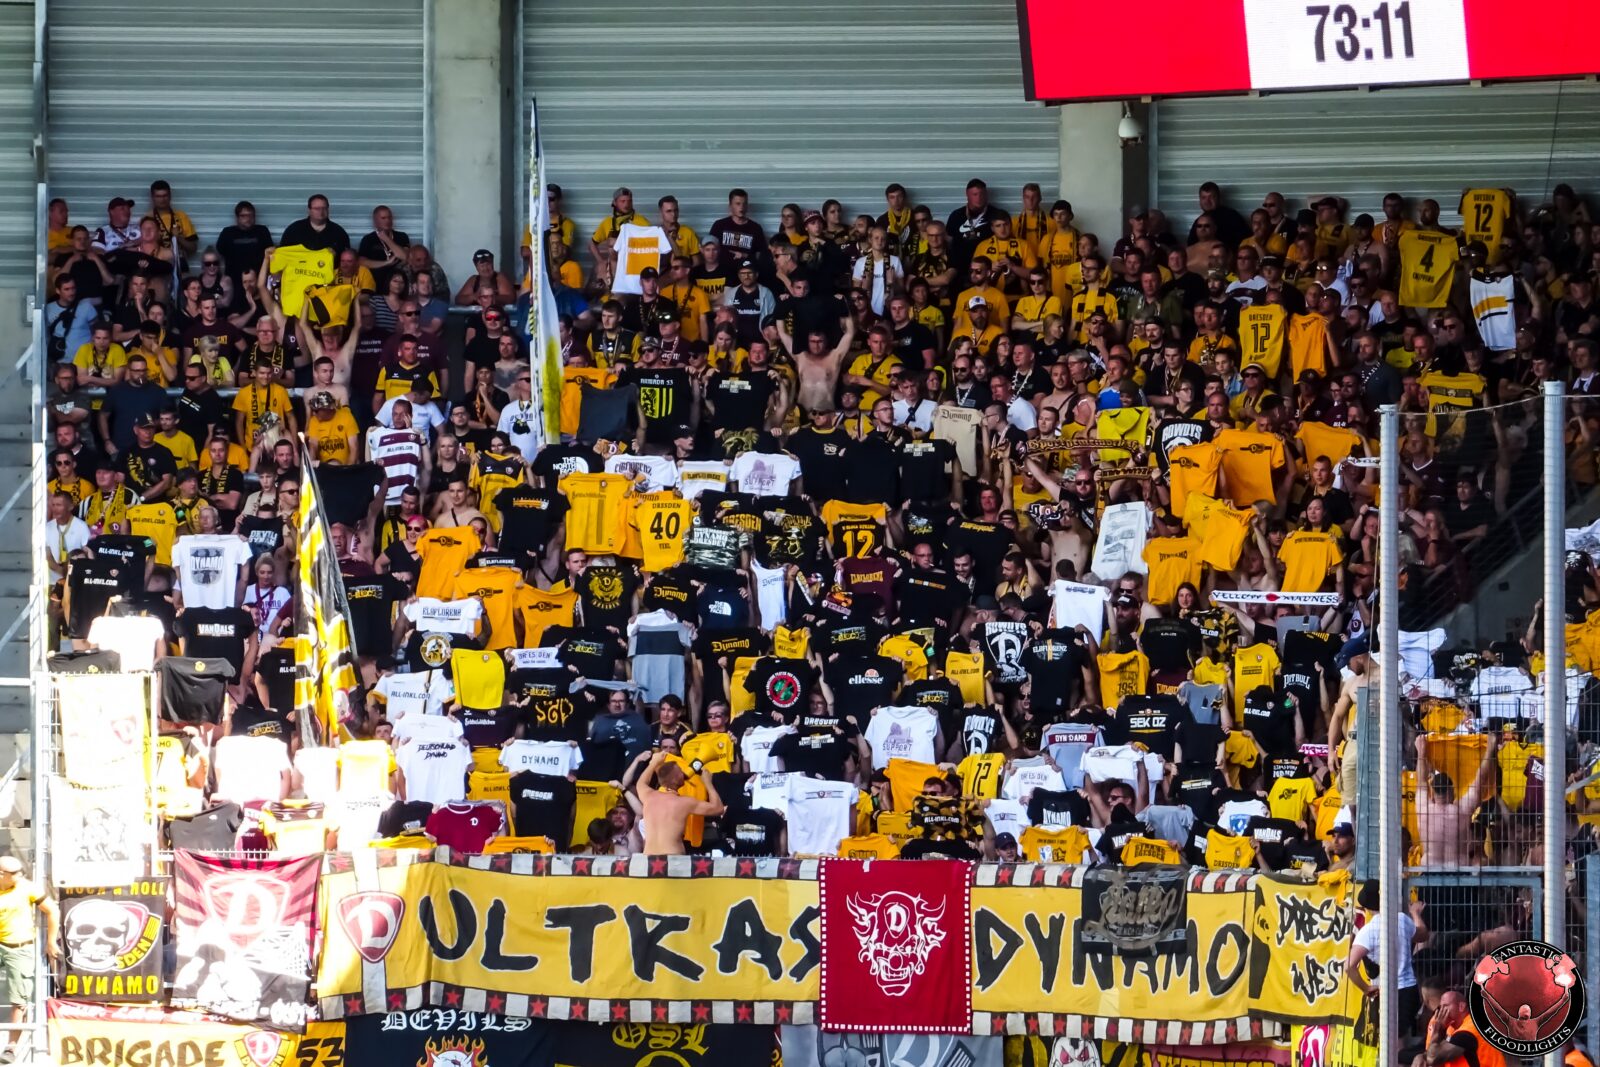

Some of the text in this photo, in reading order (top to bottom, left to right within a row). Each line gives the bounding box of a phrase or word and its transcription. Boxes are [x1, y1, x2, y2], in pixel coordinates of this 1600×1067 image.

[1306, 3, 1415, 62] 73:11
[1474, 203, 1494, 233] 12
[1420, 244, 1435, 273] 4
[294, 267, 326, 279] DRESDEN
[1251, 323, 1270, 353] 12
[1162, 423, 1202, 442] ROWDYS
[650, 512, 681, 540] 40
[843, 529, 875, 559] 12
[190, 555, 224, 569] DYNAMO
[849, 674, 884, 685] ellesse
[1130, 717, 1150, 728] SEK
[521, 756, 560, 766] DYNAMO
[1043, 808, 1071, 827] DYNAMO
[66, 975, 160, 996] DYNAMO
[381, 1009, 533, 1032] DEVILS
[60, 1035, 226, 1067] BRIGADE
[295, 1037, 345, 1062] 53
